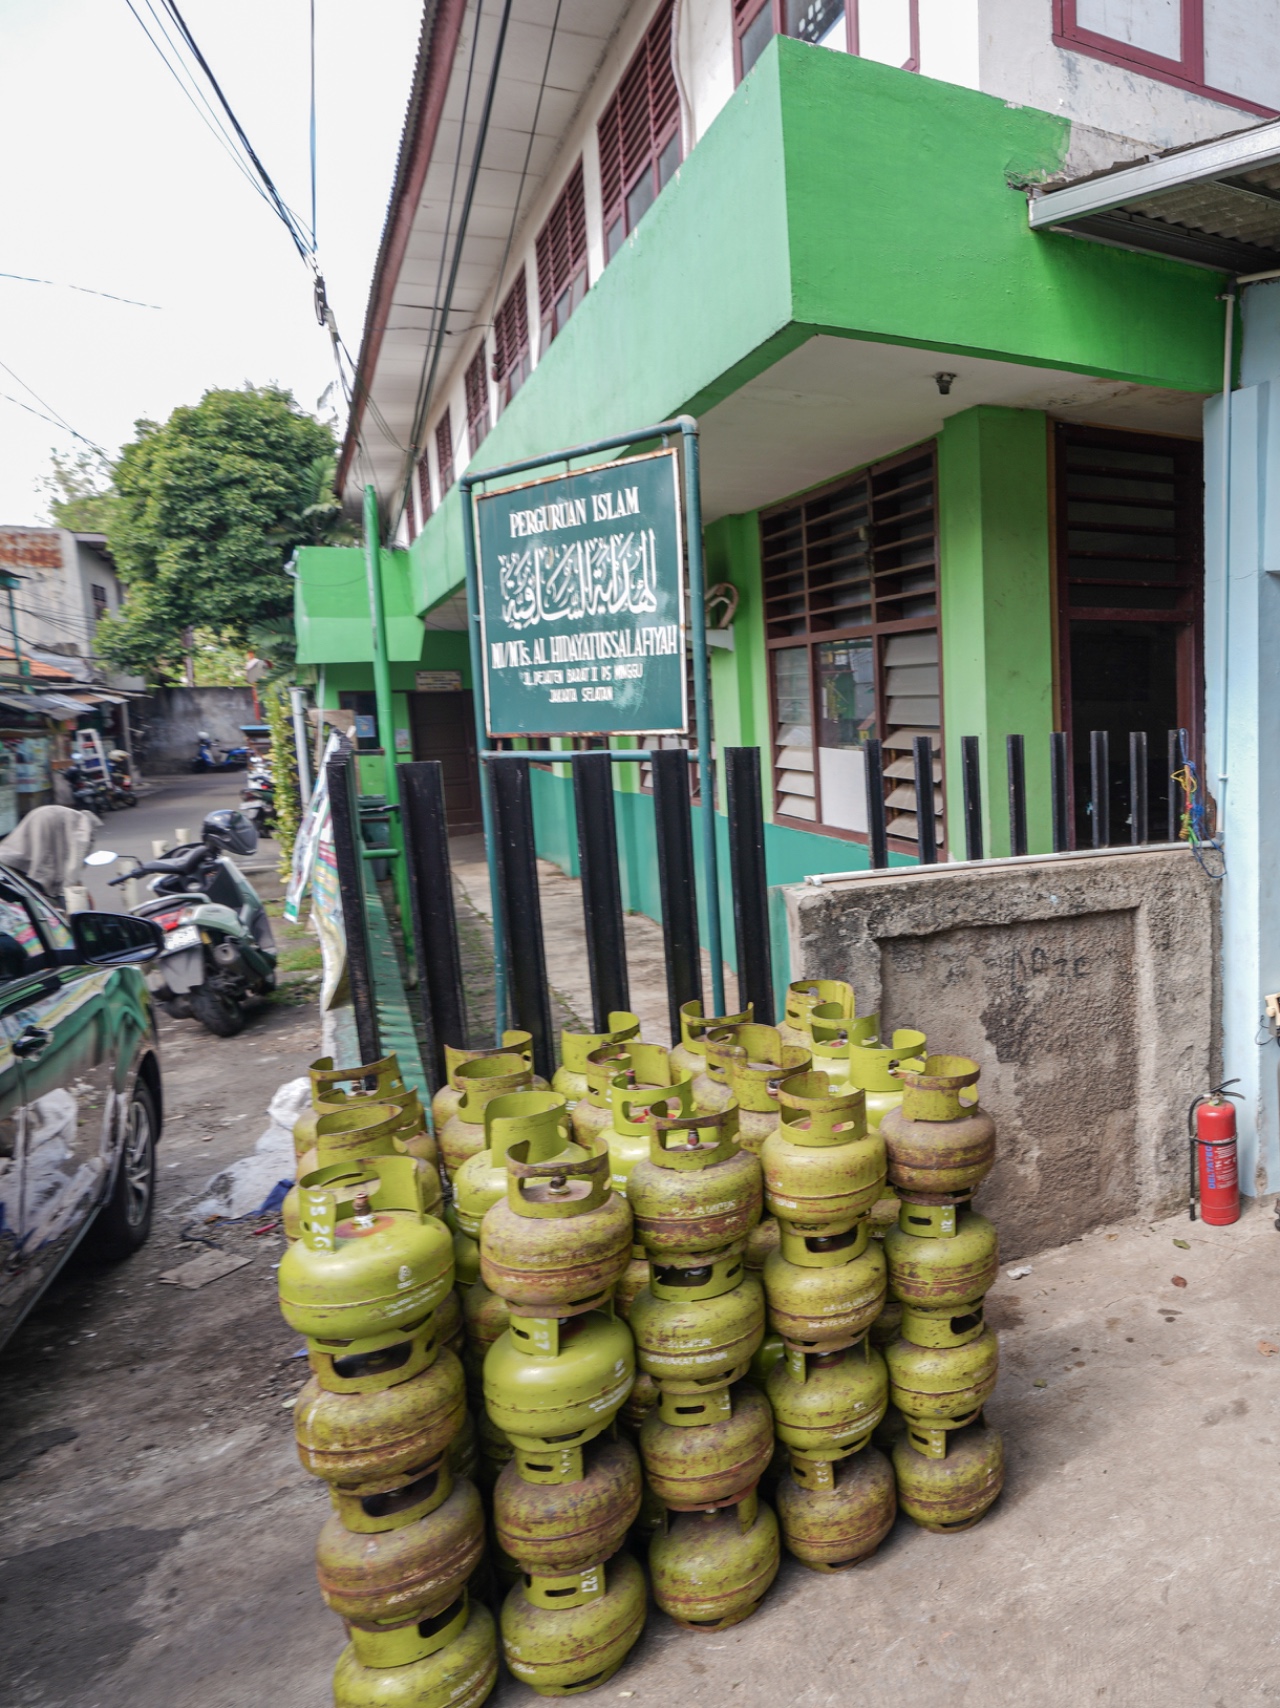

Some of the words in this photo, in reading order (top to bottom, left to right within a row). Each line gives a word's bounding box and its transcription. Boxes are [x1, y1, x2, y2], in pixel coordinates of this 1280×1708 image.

[509, 498, 587, 538] PERGURUAN
[592, 486, 640, 522] ISLAM
[1204, 1139, 1216, 1189] DELTATEC
